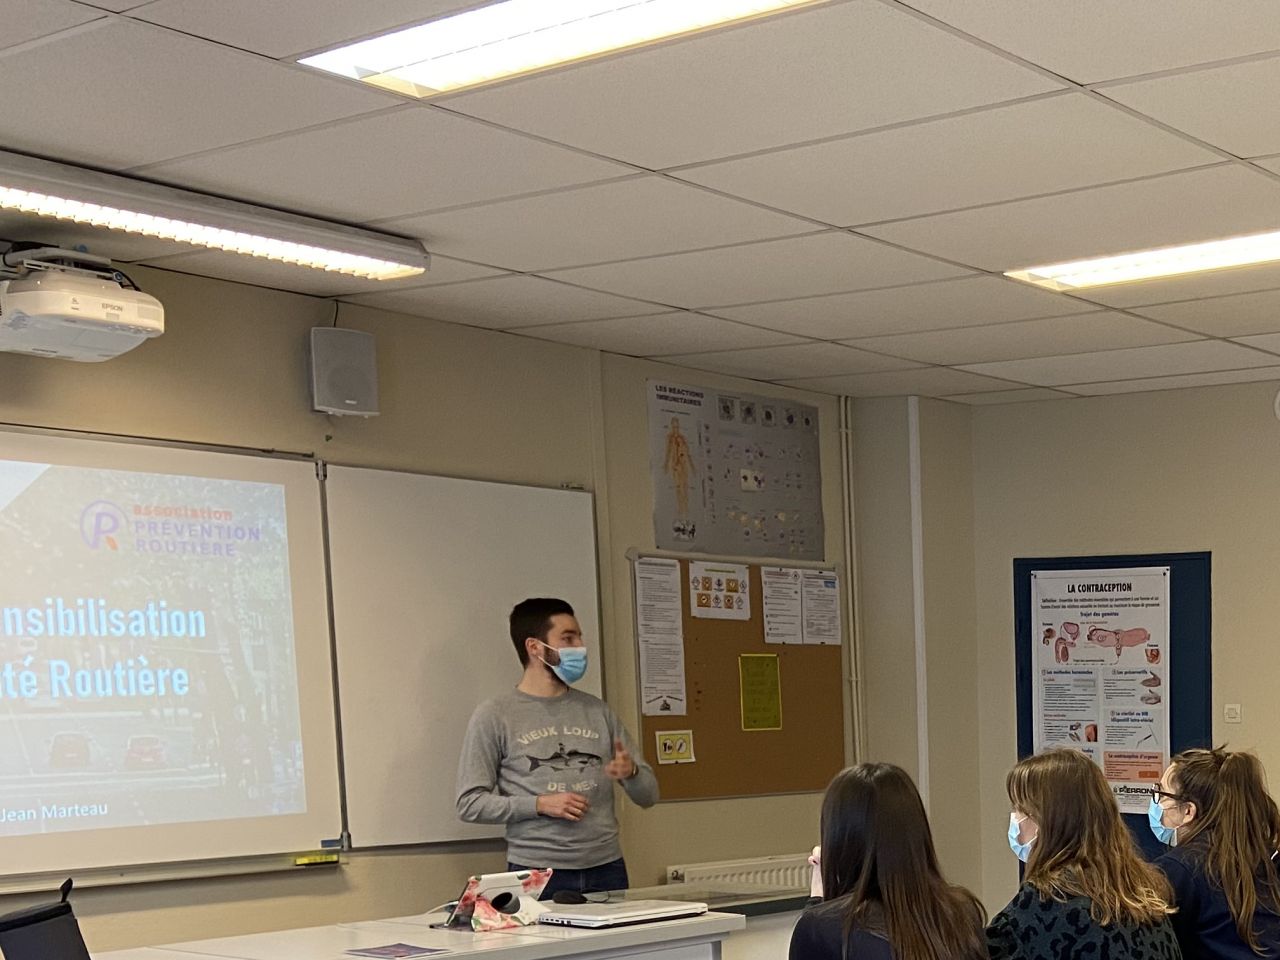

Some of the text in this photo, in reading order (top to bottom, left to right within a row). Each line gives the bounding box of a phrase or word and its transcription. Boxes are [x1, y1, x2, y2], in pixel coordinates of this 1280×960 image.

[102, 303, 123, 312] EPSON
[134, 504, 232, 520] association
[135, 520, 261, 540] PRÉVENTION
[136, 540, 235, 556] ROUTIÈRE
[1068, 583, 1132, 593] LA CONTRACEPTION
[0, 656, 189, 697] té Routière
[518, 726, 557, 745] VIEUX
[548, 782, 566, 792] DE
[0, 803, 108, 822] Jean Marteau
